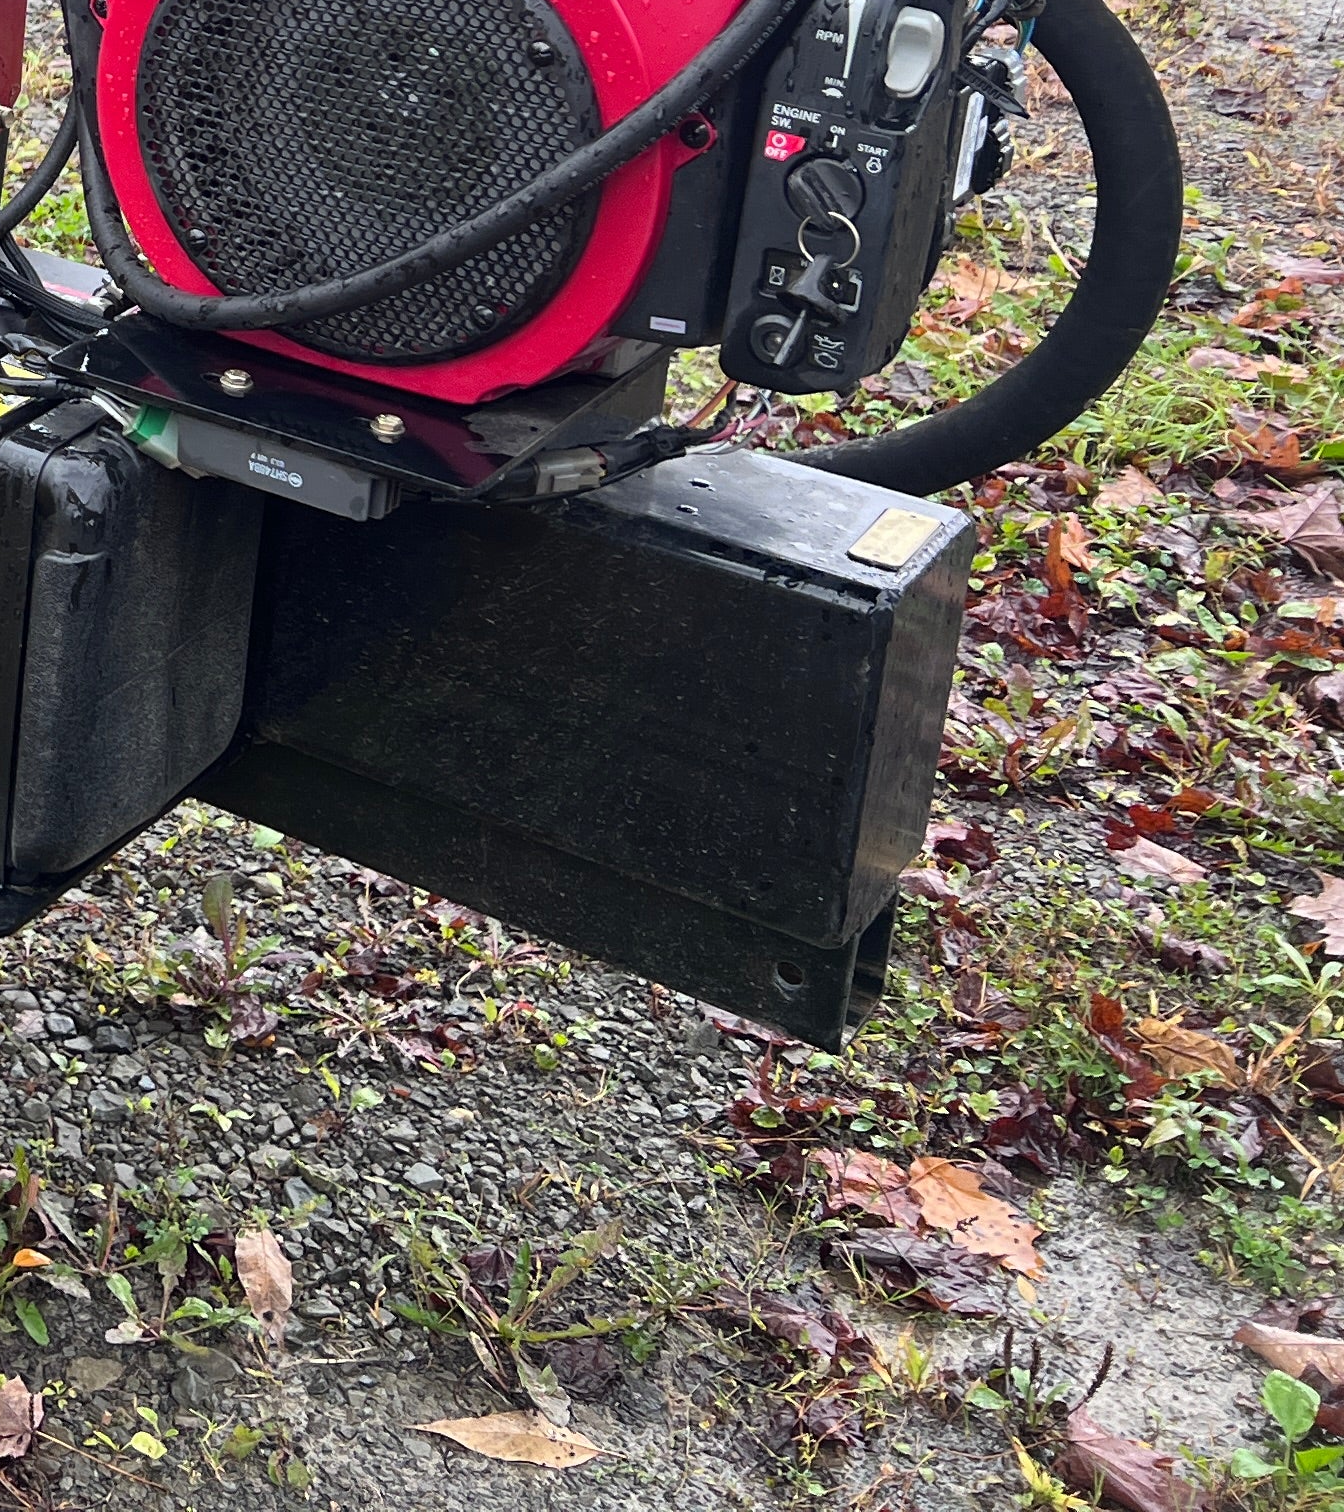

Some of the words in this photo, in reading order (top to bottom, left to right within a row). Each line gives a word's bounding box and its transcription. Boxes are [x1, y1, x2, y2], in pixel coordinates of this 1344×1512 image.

[815, 29, 845, 45] RPM
[772, 103, 822, 125] ENGINE
[771, 115, 792, 130] SW.
[829, 125, 846, 137] ON
[765, 145, 789, 160] OFF
[856, 142, 889, 157] START
